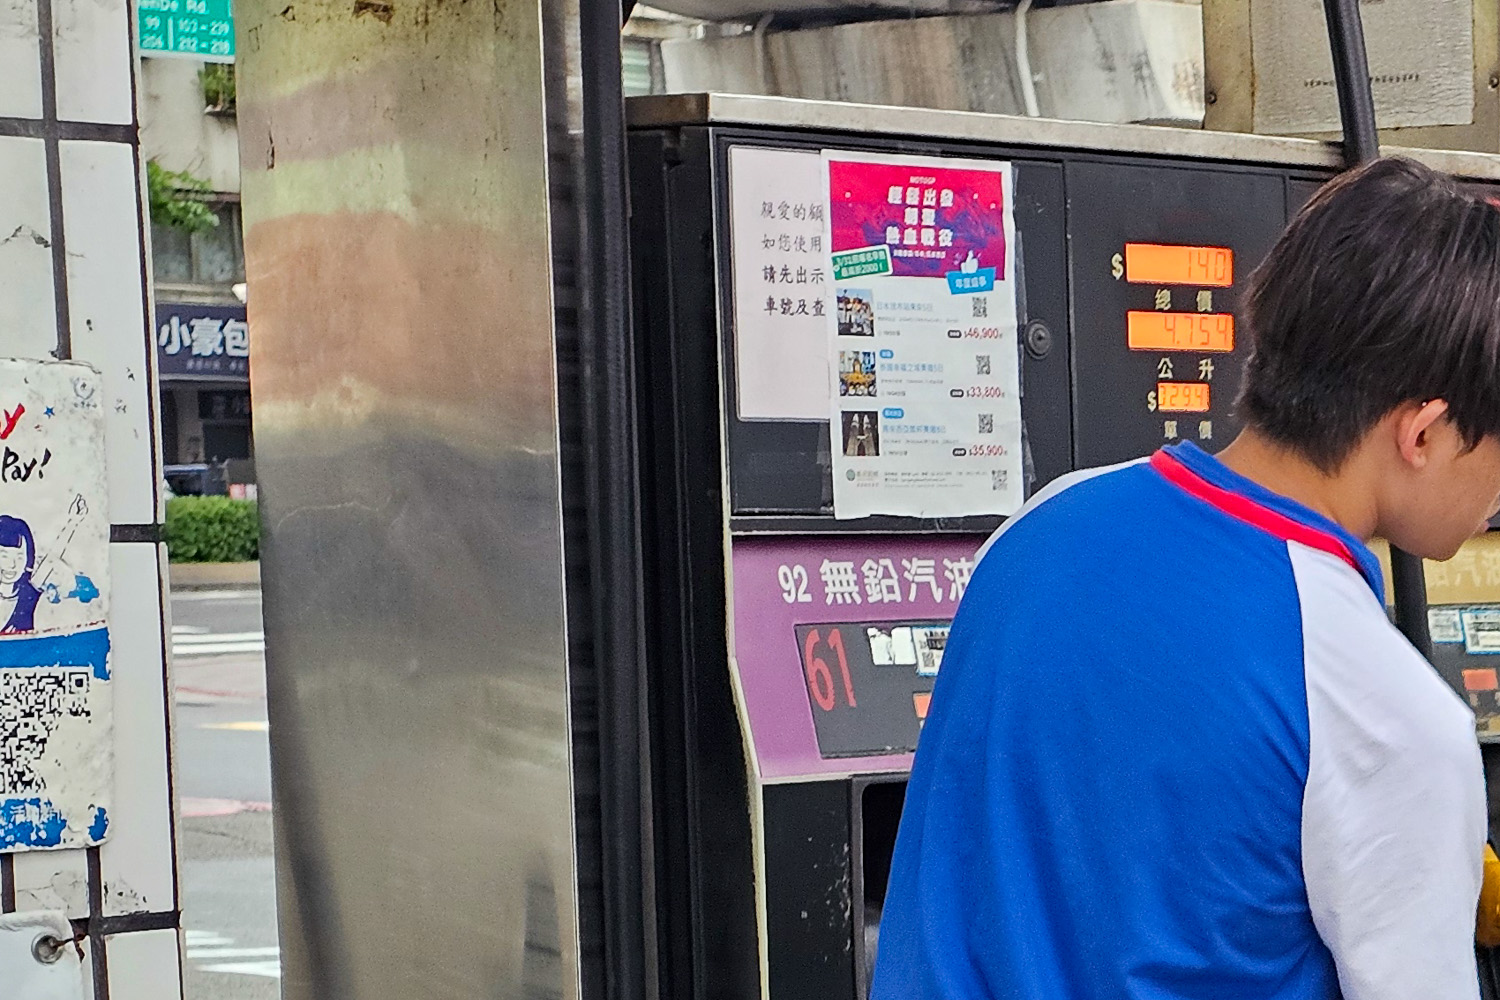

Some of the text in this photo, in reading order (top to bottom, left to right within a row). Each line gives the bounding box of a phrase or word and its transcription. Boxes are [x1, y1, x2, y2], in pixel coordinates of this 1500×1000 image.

[761, 233, 822, 254] 如您使用
[762, 264, 825, 285] 請先出示
[1187, 251, 1227, 281] 140
[763, 295, 826, 317] 車號及查
[1164, 316, 1229, 346] 4.754
[1157, 357, 1215, 380] 公升
[1, 445, 52, 484] Pay!
[777, 564, 813, 605] 92
[804, 627, 857, 712] 61
